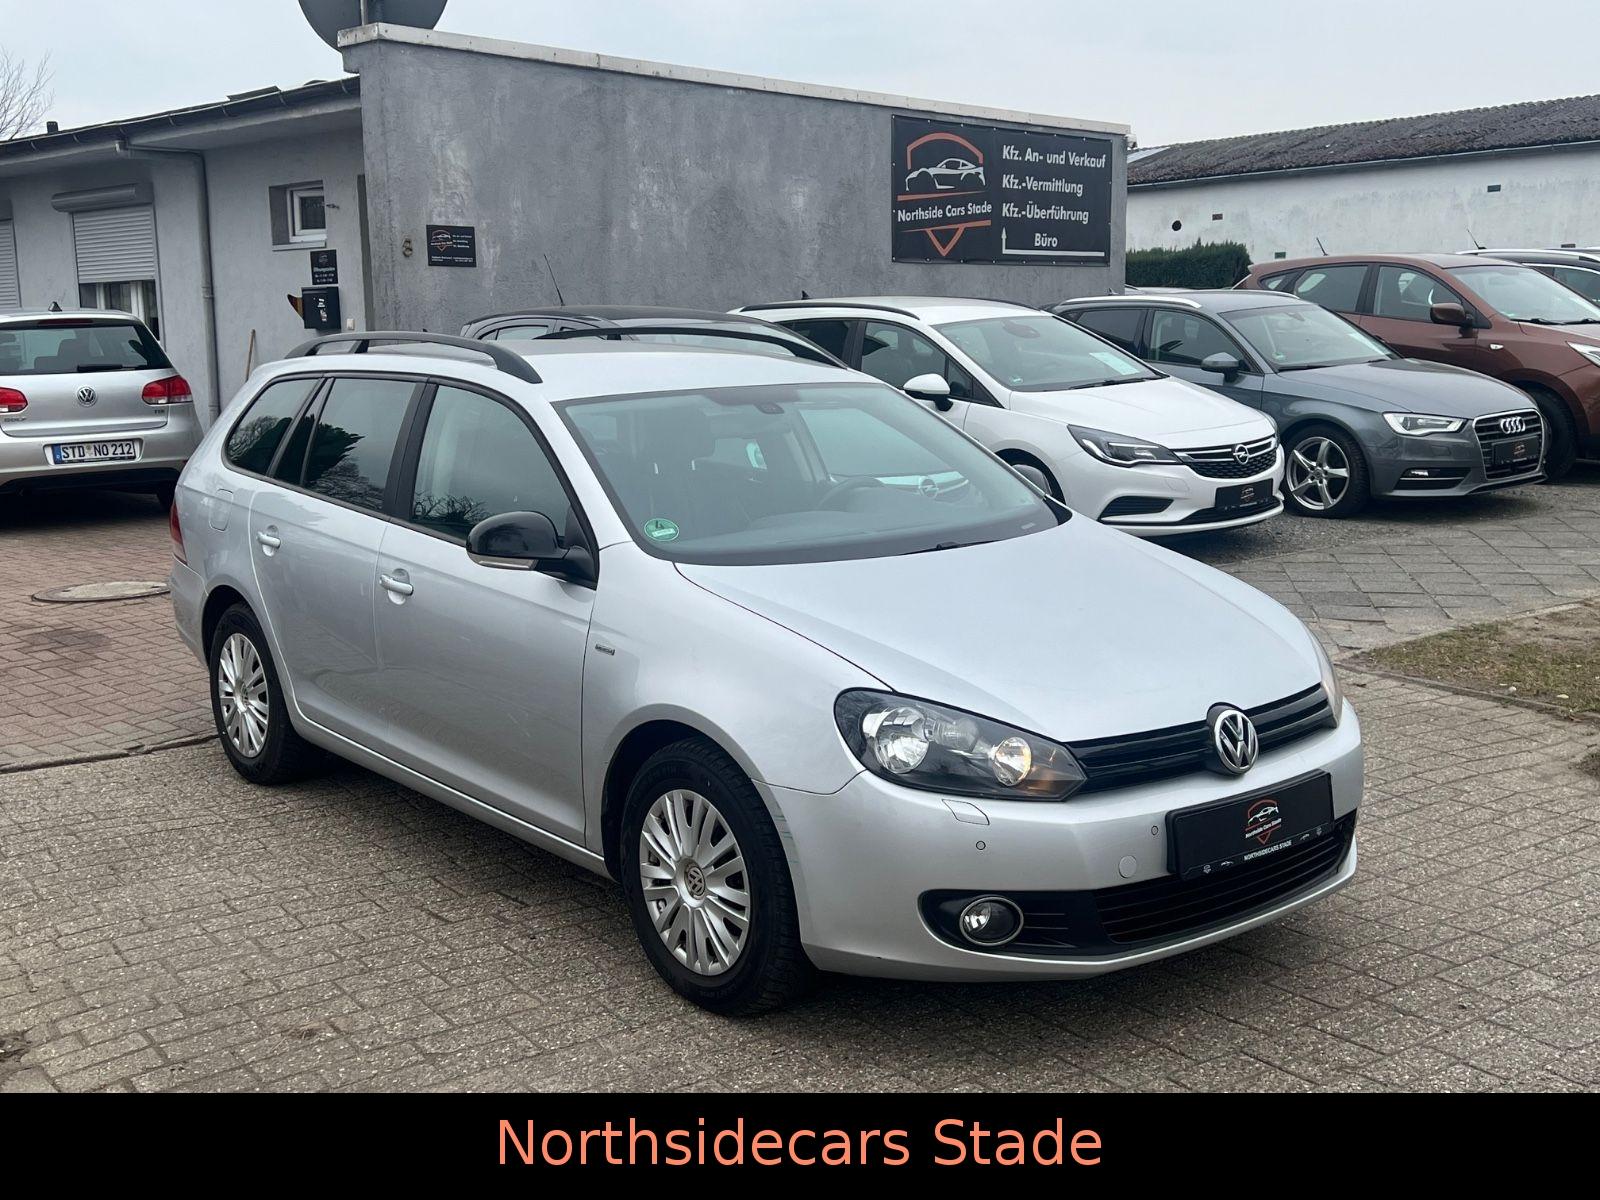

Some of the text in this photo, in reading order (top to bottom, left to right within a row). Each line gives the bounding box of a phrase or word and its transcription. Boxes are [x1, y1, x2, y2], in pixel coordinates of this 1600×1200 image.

[1002, 144, 1106, 168] Kfz. An- und Verkauf
[1002, 174, 1083, 197] Kfz.-Vermittlung
[897, 200, 992, 222] Northside Cars Stade
[1002, 201, 1089, 224] Kfz.-Überführung
[1034, 233, 1058, 247] Büro
[62, 440, 133, 459] STD NO 212
